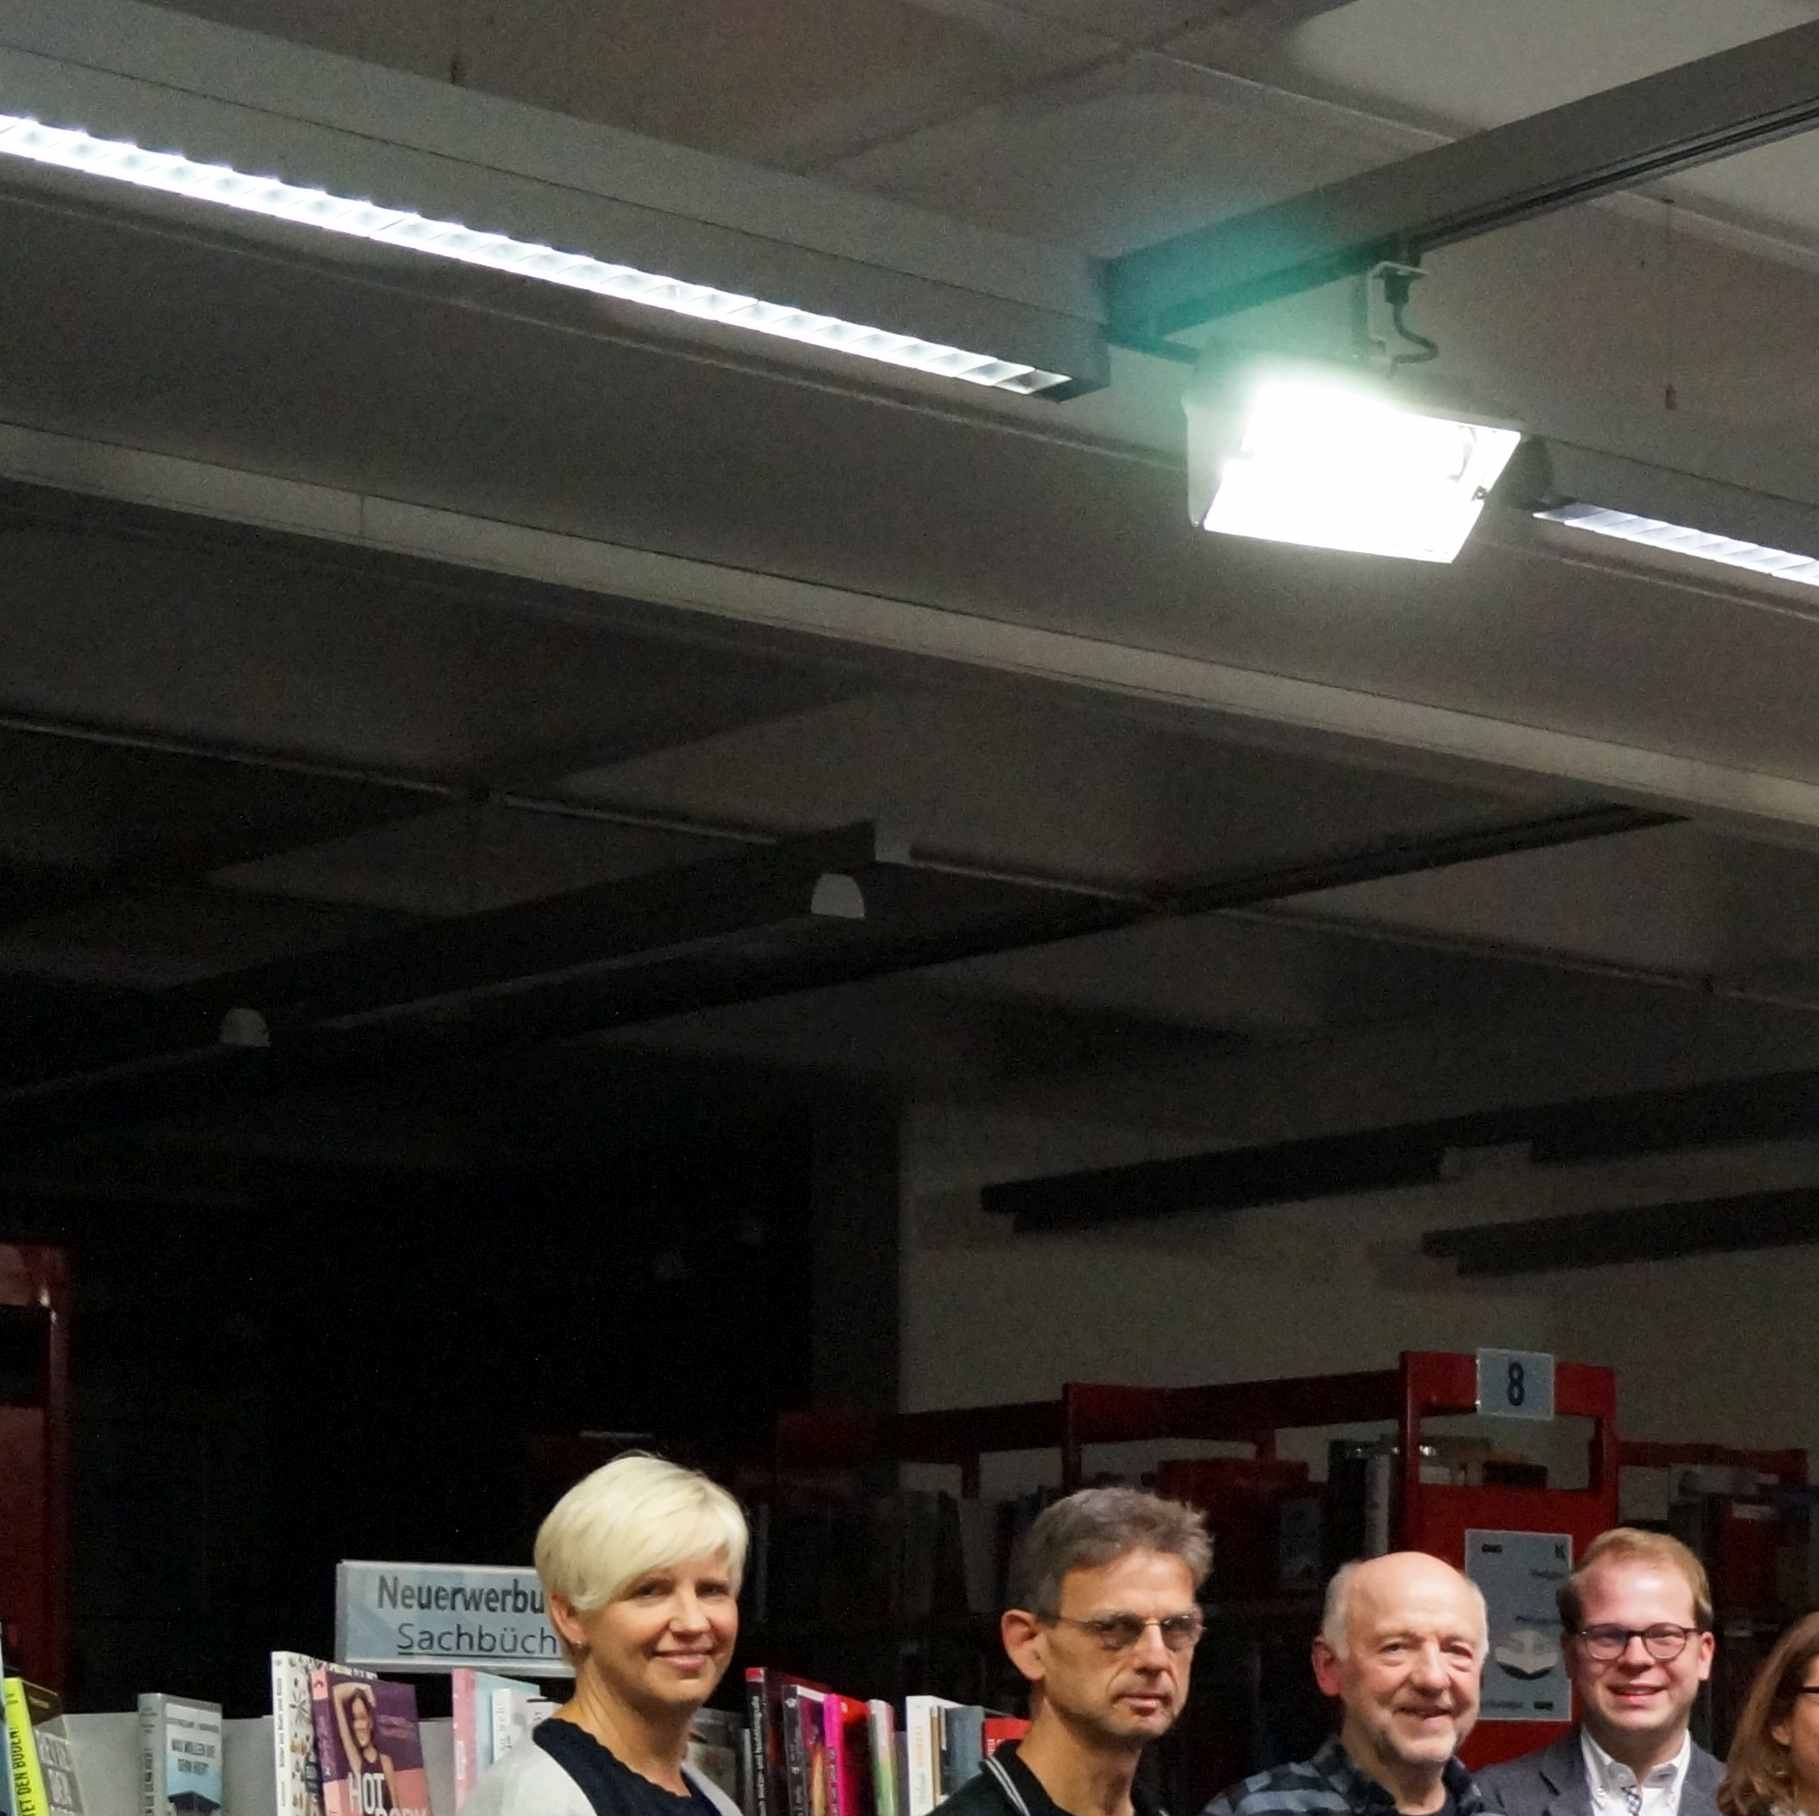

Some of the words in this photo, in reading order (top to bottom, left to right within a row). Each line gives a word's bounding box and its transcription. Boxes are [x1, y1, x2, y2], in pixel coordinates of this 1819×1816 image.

[1507, 1361, 1525, 1407] 8
[377, 1574, 545, 1614] Neuerwerbu
[397, 1622, 557, 1654] Sachbüch
[14, 1769, 33, 1795] DEN
[349, 1772, 386, 1816] HOT
